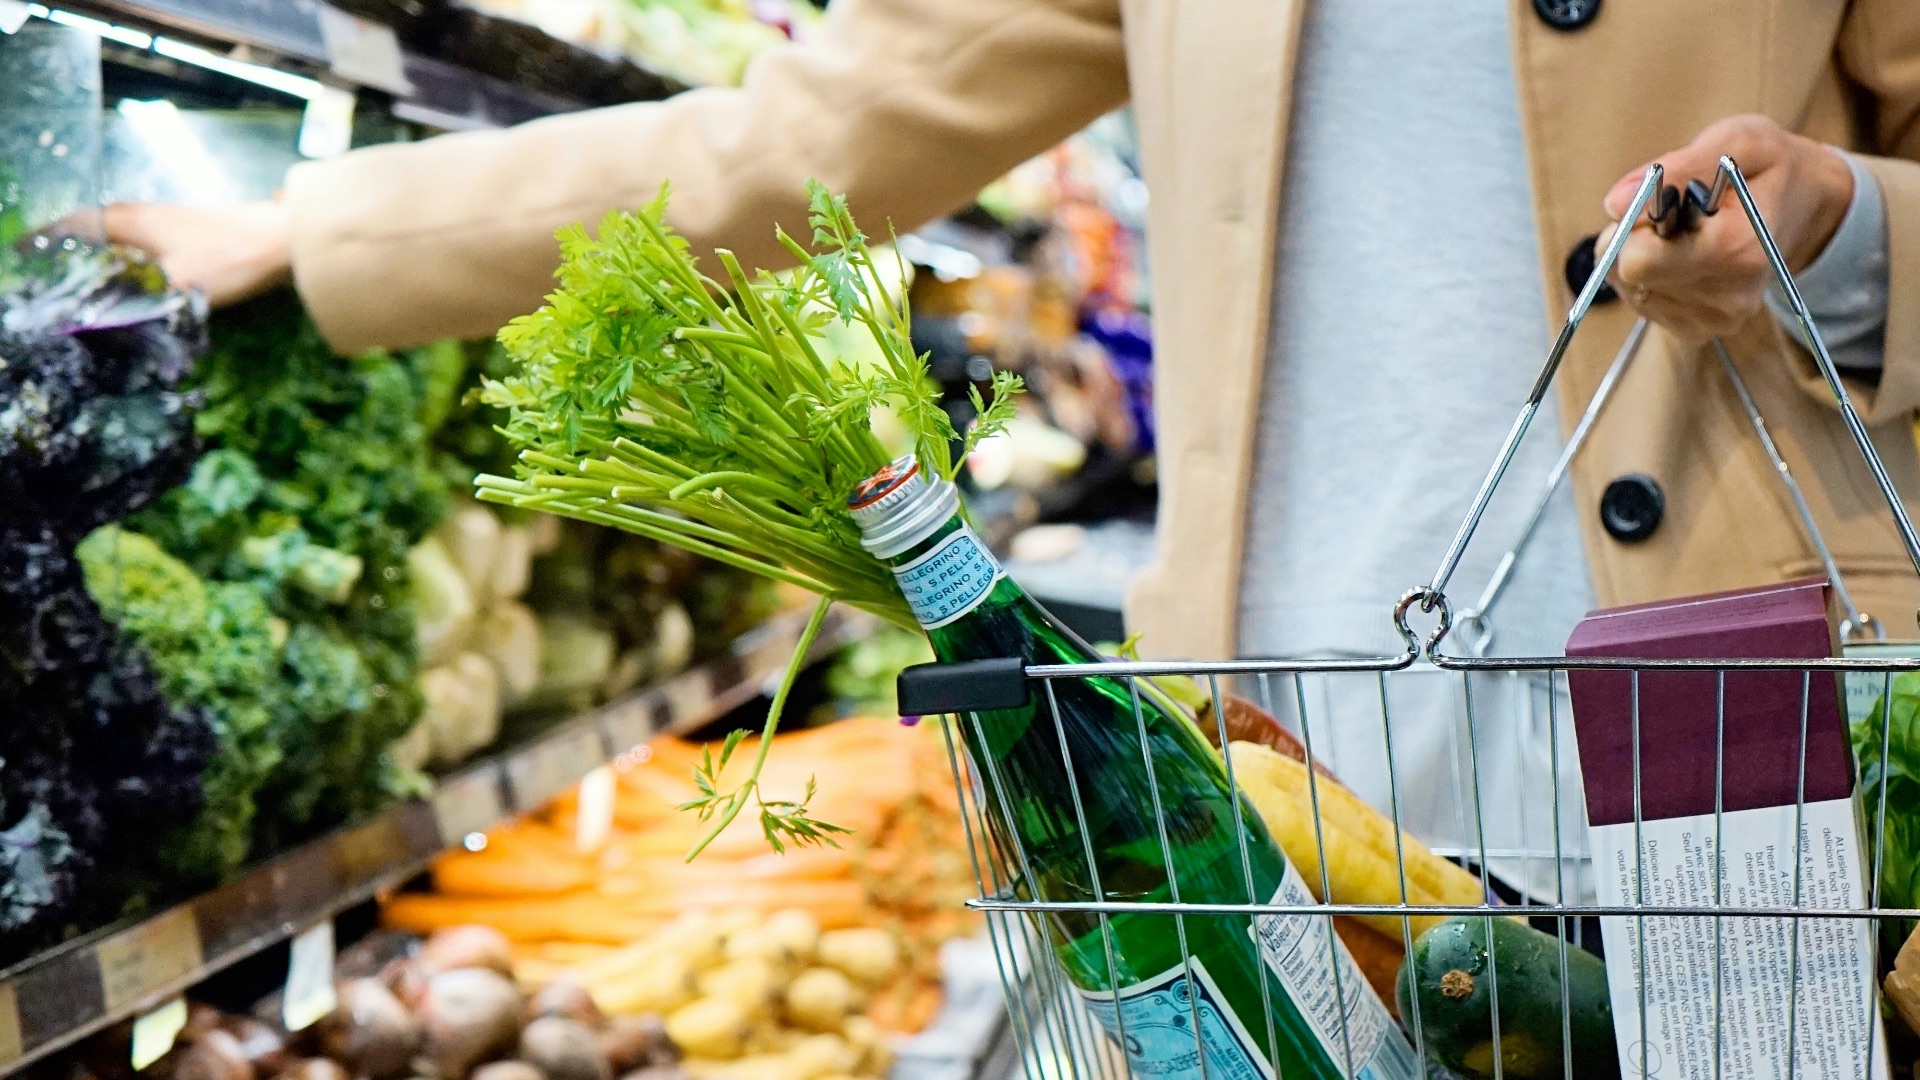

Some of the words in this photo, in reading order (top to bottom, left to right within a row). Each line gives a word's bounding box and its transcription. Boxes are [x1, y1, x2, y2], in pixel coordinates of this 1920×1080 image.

[1682, 831, 1693, 853] Seul
[1798, 822, 1810, 853] Lesley
[1823, 827, 1834, 868] delicious
[1835, 836, 1844, 847] At
[1617, 849, 1626, 871] vous
[1648, 839, 1659, 882] Délicieux
[1686, 855, 1693, 867] un
[1695, 846, 1704, 868] avec
[1756, 851, 1765, 866] but
[1766, 845, 1775, 871] these
[1837, 848, 1847, 879] Lesley
[1621, 874, 1628, 886] ne
[1745, 852, 1755, 886] cheese
[1780, 870, 1789, 878] A
[1806, 865, 1814, 881] her
[1654, 884, 1661, 896] au
[1686, 870, 1699, 902] produit
[1698, 870, 1707, 892] soin,
[1758, 868, 1768, 893] really
[1770, 873, 1780, 905] unique
[1829, 871, 1839, 894] food.
[1702, 895, 1709, 907] en
[1722, 882, 1731, 906] Stow
[1738, 886, 1747, 907] snac
[1750, 888, 1757, 898] or
[1809, 884, 1817, 908] team
[1841, 882, 1850, 909] Stow
[1762, 896, 1772, 921] she
[1832, 896, 1843, 925] The
[1626, 925, 1636, 945] plus
[1649, 925, 1657, 936] de
[1683, 916, 1694, 949] pouvait
[1766, 923, 1774, 949] when
[1825, 926, 1833, 945] with
[1846, 917, 1854, 935] ine
[1661, 936, 1669, 953] ces
[1672, 931, 1684, 962] POUR
[1705, 836, 1713, 848] de
[1722, 957, 1732, 996] fabuleux
[1727, 999, 1738, 1045] craquelins
[1733, 1048, 1742, 1068] sont
[1730, 937, 1740, 966] Foods
[1802, 924, 1814, 958] scratch
[1815, 935, 1823, 951] the
[1836, 927, 1847, 967] fabulous
[1651, 939, 1663, 985] trempette,
[1697, 940, 1709, 978] fabriqué
[1746, 949, 1754, 964] are
[1758, 947, 1766, 963] We
[1779, 949, 1787, 965] are
[1817, 953, 1826, 972] only
[1827, 947, 1836, 968] care
[1849, 938, 1859, 967] Foods
[1676, 964, 1687, 986] CES
[1688, 952, 1699, 993] satisfaire
[1749, 967, 1757, 987] sure
[1760, 965, 1768, 980] are
[1768, 951, 1781, 983] topped
[1807, 960, 1816, 985] using
[1831, 970, 1838, 979] in
[1852, 969, 1860, 983] we
[1664, 955, 1676, 1002] craquelins
[1734, 968, 1743, 995] adore
[1820, 975, 1828, 993] way
[1841, 969, 1851, 997] crisps
[1658, 988, 1666, 999] de
[1680, 988, 1690, 1012] FINS
[1702, 981, 1710, 1002] avec
[1750, 990, 1760, 1007] you
[1762, 983, 1774, 1022] addicted
[1774, 985, 1783, 1004] with
[1823, 996, 1830, 1005] to
[1832, 981, 1842, 1006] small
[1855, 985, 1863, 1005] love
[1660, 1002, 1670, 1040] fromage
[1671, 1004, 1679, 1024] sont
[1693, 996, 1703, 1025] Lesley
[1738, 998, 1748, 1038] fabriquer
[1755, 1009, 1764, 1023] will
[1775, 1006, 1785, 1026] your
[1813, 1005, 1823, 1030] finest
[1825, 1007, 1833, 1033] make
[1846, 1000, 1854, 1021] from
[1698, 1028, 1706, 1037] et
[1757, 1025, 1765, 1038] be
[1768, 1025, 1775, 1034] to
[1835, 1008, 1846, 1048] batches.
[1857, 1007, 1868, 1041] making
[1665, 1042, 1672, 1054] ou
[1674, 1027, 1686, 1078] irrésistibles
[1699, 1039, 1707, 1056] son
[1719, 1026, 1730, 1058] cuisine
[1743, 1041, 1751, 1050] et
[1759, 1040, 1767, 1056] too.
[1769, 1036, 1778, 1053] this
[1848, 1023, 1860, 1060] Lesley's
[1725, 1060, 1733, 1073] de
[1745, 1052, 1753, 1074] vous
[1827, 1044, 1839, 1068] great
